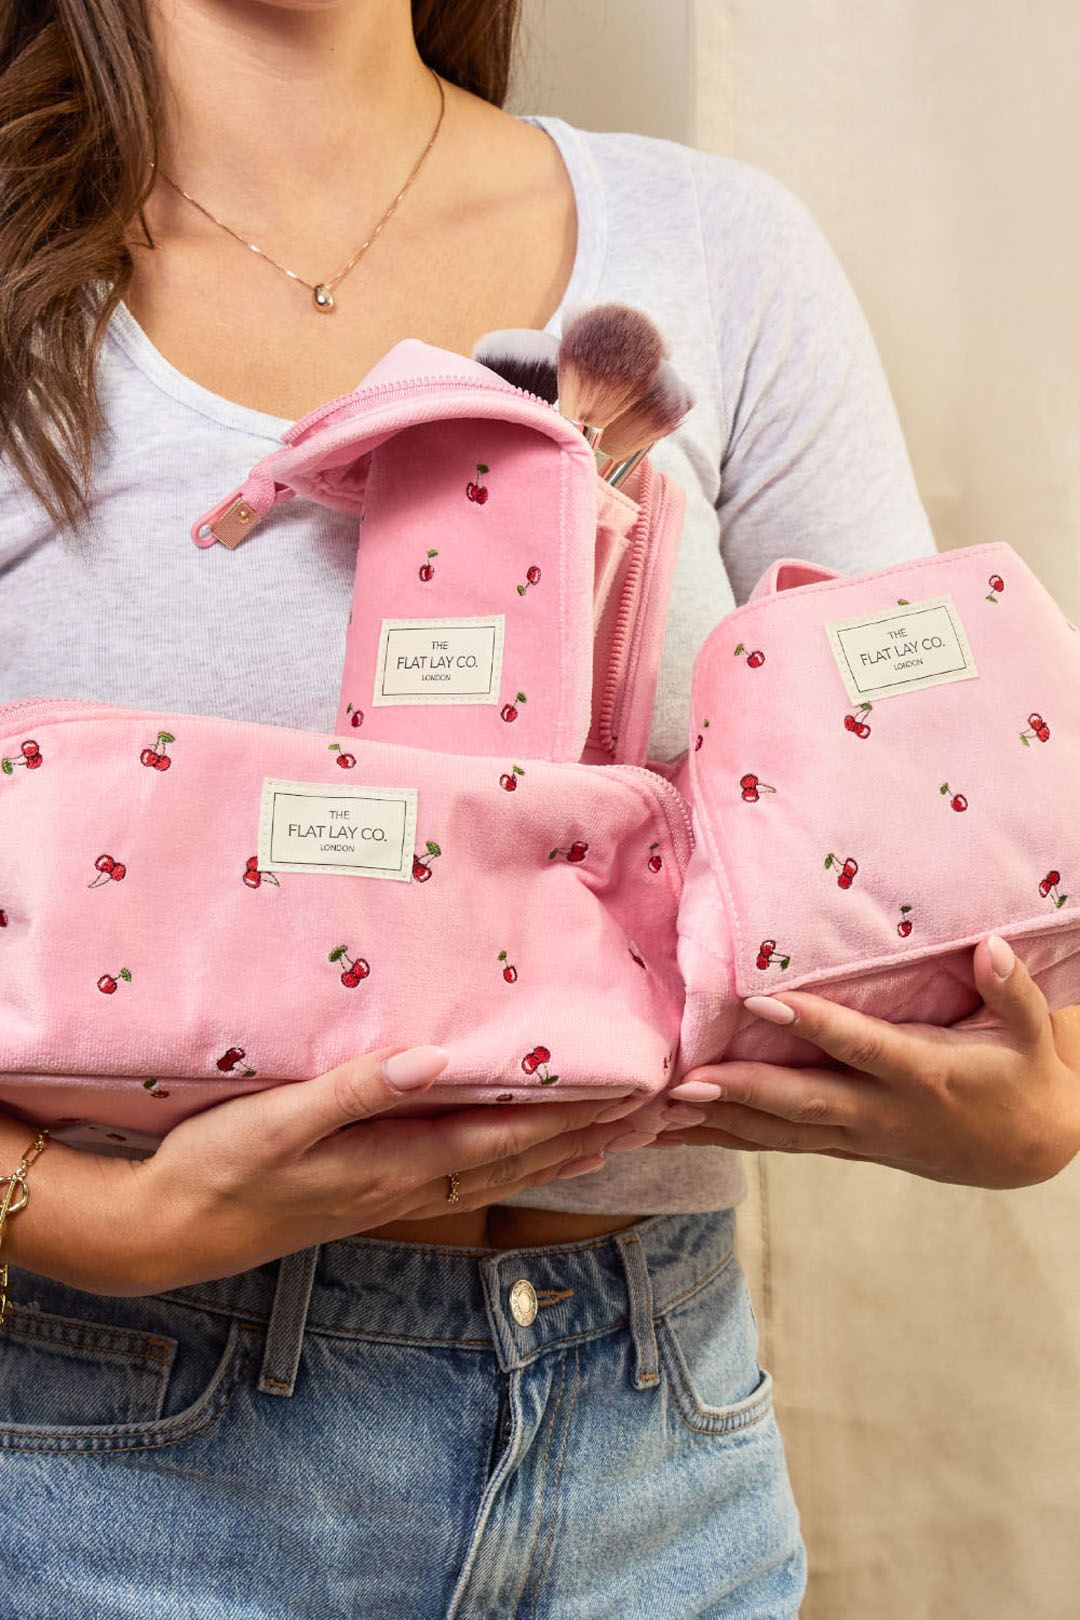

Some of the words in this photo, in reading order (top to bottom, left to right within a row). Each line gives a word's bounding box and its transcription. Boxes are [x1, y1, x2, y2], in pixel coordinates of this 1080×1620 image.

[888, 628, 907, 640] THE
[432, 641, 448, 650] THE
[860, 647, 892, 666] FLAT
[894, 641, 918, 657] LAY
[921, 636, 946, 651] CO.
[397, 656, 428, 669] FLAT
[430, 656, 454, 669] LAY
[456, 655, 478, 668] CO.
[893, 658, 924, 671] LONDON
[329, 810, 350, 820] THE
[288, 823, 326, 838] FLAT
[328, 825, 358, 840] LAY
[361, 827, 388, 842] CO.
[320, 843, 355, 852] LONDON
